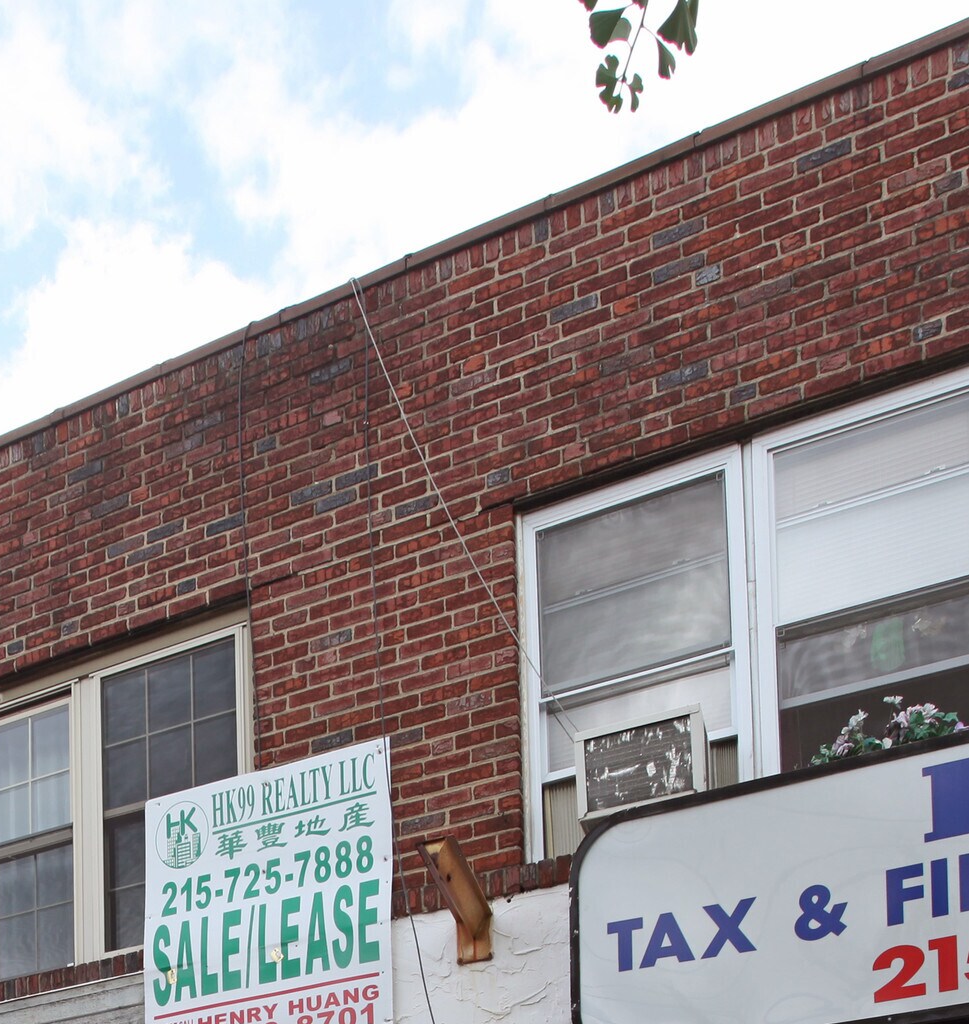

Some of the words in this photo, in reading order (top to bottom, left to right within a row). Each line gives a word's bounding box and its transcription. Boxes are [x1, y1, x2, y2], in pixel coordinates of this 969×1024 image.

[211, 784, 255, 828] HK99
[262, 763, 333, 816] REALTY
[340, 752, 377, 798] LLC
[162, 835, 374, 917] 215-725-7888
[153, 879, 380, 1007] SALE/LEASE
[606, 896, 757, 973] TAX
[794, 884, 848, 942] &
[288, 984, 380, 1014] HUANG
[872, 935, 969, 1004] 21
